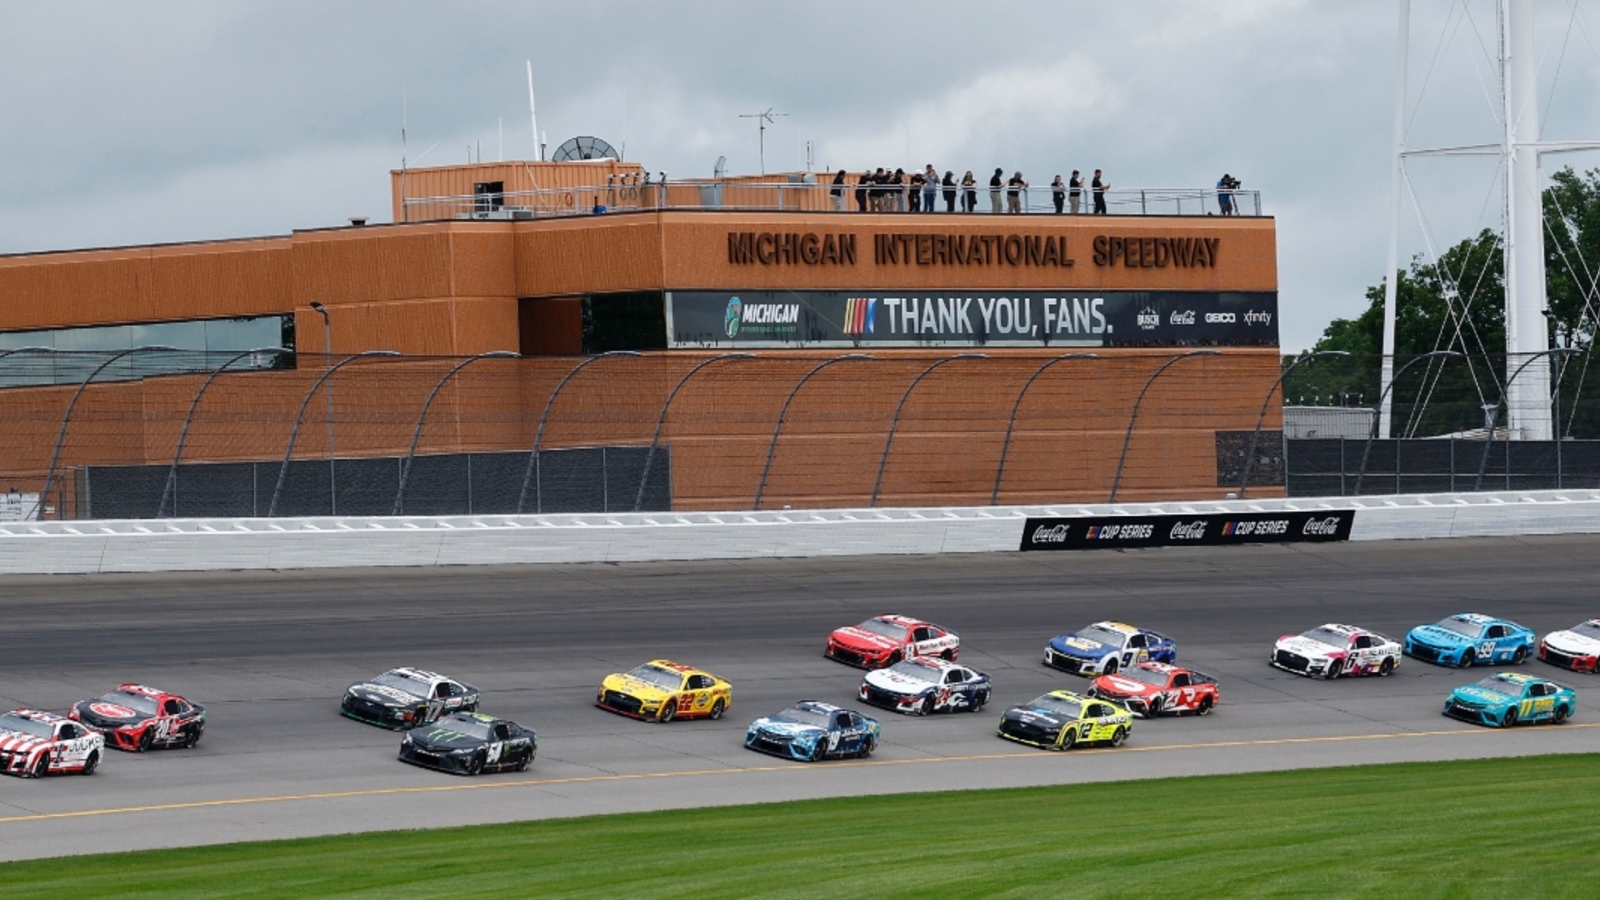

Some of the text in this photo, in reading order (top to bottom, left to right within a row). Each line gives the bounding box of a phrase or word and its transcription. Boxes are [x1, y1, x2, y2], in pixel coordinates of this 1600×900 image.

[727, 231, 1221, 268] MICHIGAN INTERNATIONAL SPEEDWAY
[742, 304, 800, 323] MICHIGAN
[883, 297, 1114, 337] THANK YOU, FANS.
[1137, 314, 1160, 326] BUSCH
[1205, 312, 1236, 323] GEICO
[1243, 309, 1272, 326] xfinity
[1099, 524, 1154, 539] CUP SERIES
[1234, 520, 1290, 535] CUP SERIES
[1120, 652, 1134, 668] 9
[1344, 652, 1360, 670] 6
[678, 692, 696, 711] 22
[1080, 722, 1095, 739] 12
